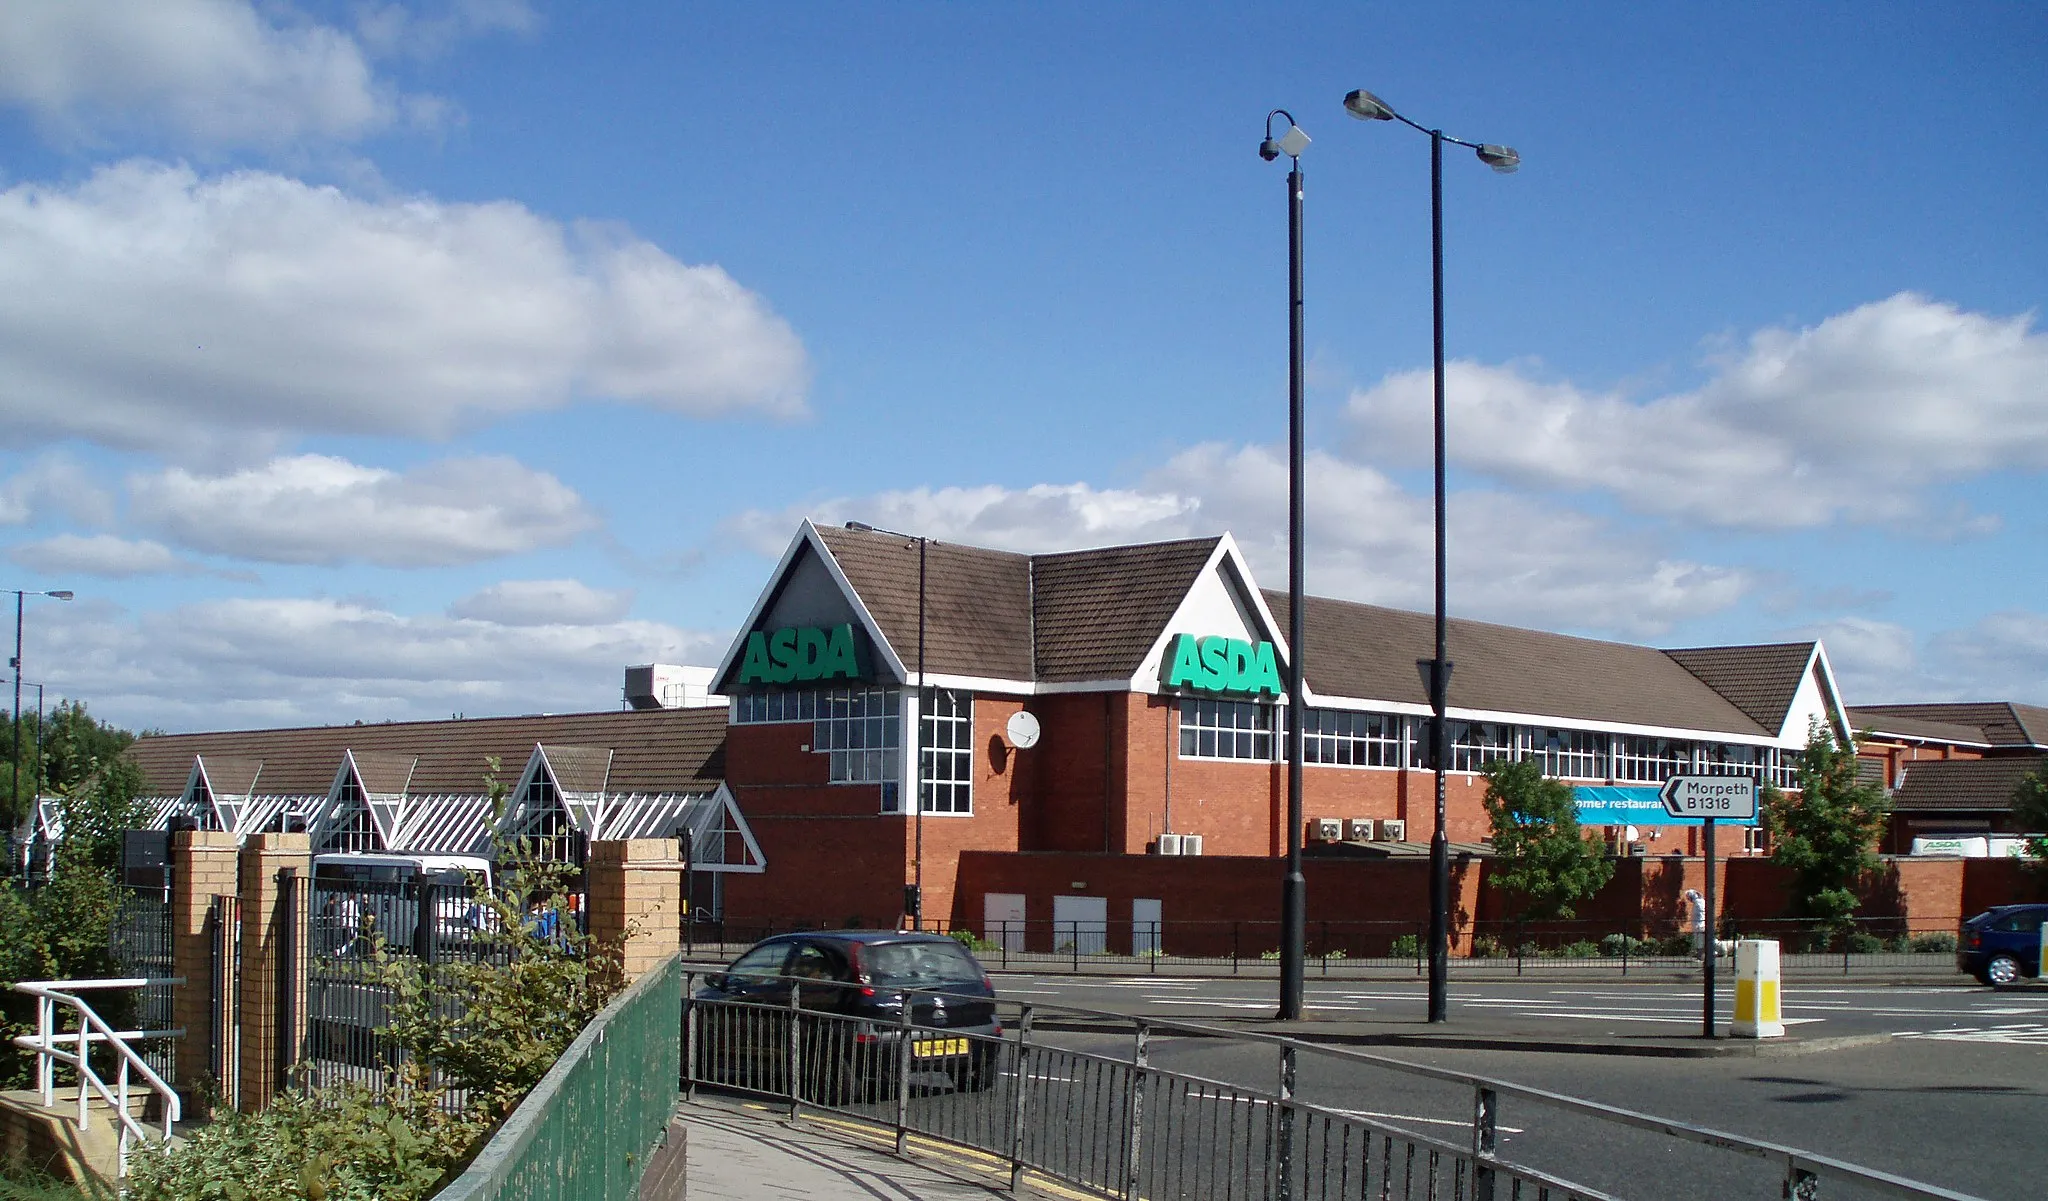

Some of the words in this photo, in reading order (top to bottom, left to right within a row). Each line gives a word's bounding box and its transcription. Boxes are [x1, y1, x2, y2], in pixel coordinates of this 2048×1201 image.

[739, 623, 860, 684] ASDA
[1167, 633, 1282, 695] ASDA
[1687, 782, 1748, 796] Morpeth
[1609, 799, 1665, 809] restauran
[1687, 797, 1730, 809] B1318
